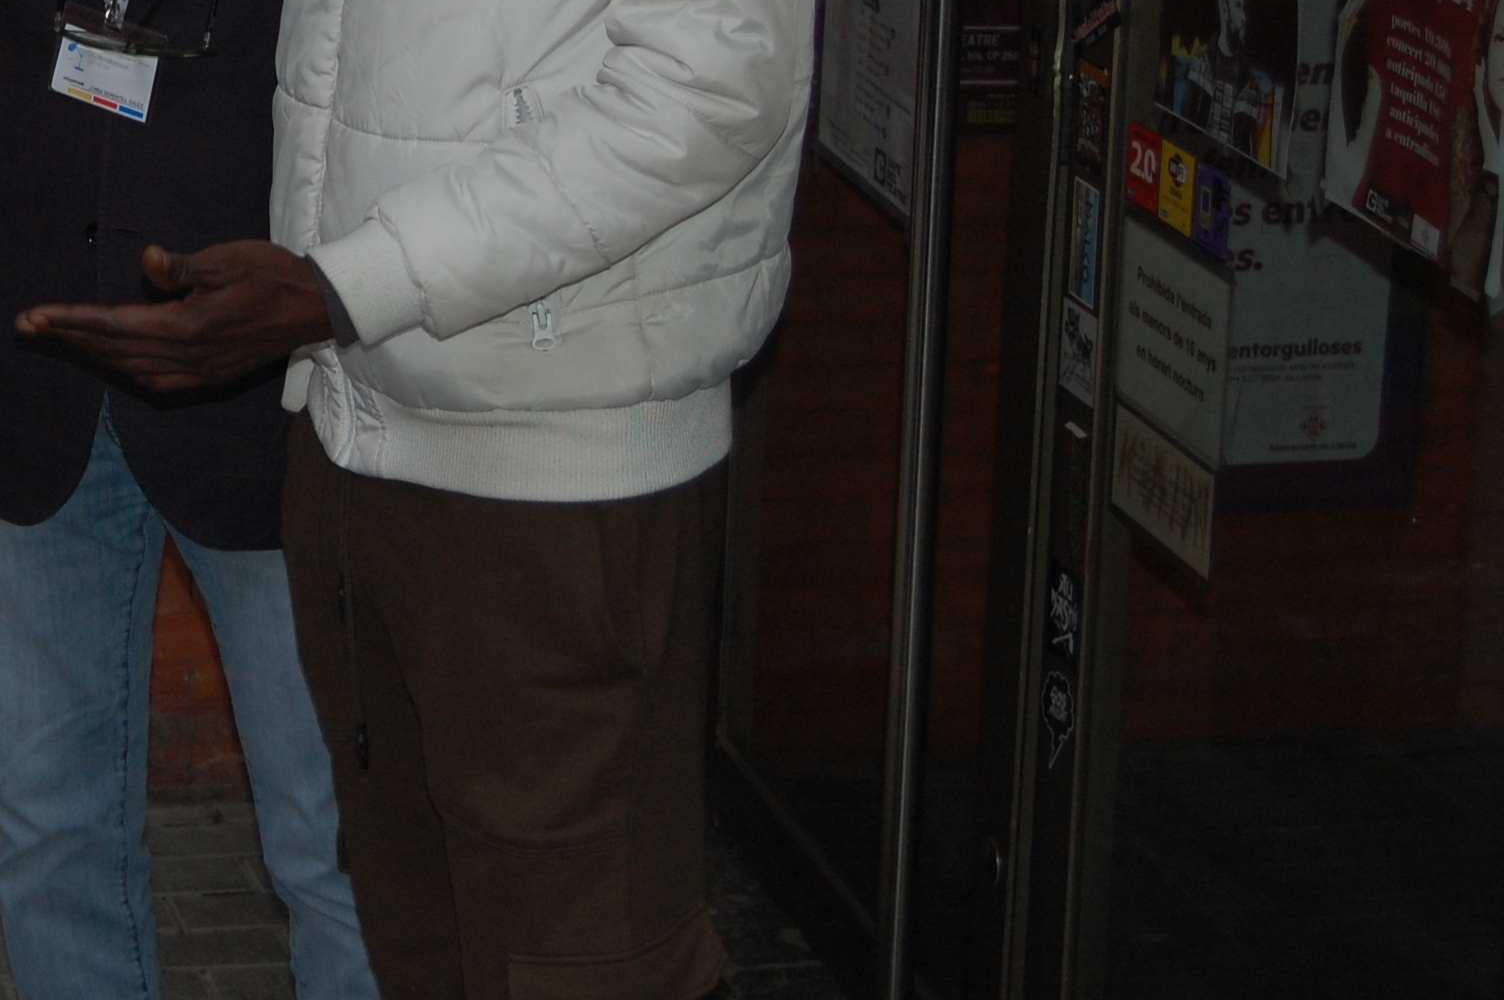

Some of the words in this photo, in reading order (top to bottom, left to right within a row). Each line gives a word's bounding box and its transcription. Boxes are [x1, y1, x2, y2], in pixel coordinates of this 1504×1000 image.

[1137, 265, 1175, 304] Prohibida
[1141, 311, 1172, 341] menors
[1173, 330, 1183, 349] de
[1197, 349, 1216, 373] anys
[1136, 345, 1146, 361] en
[1148, 349, 1172, 378] horari
[1172, 370, 1204, 402] nocturn
